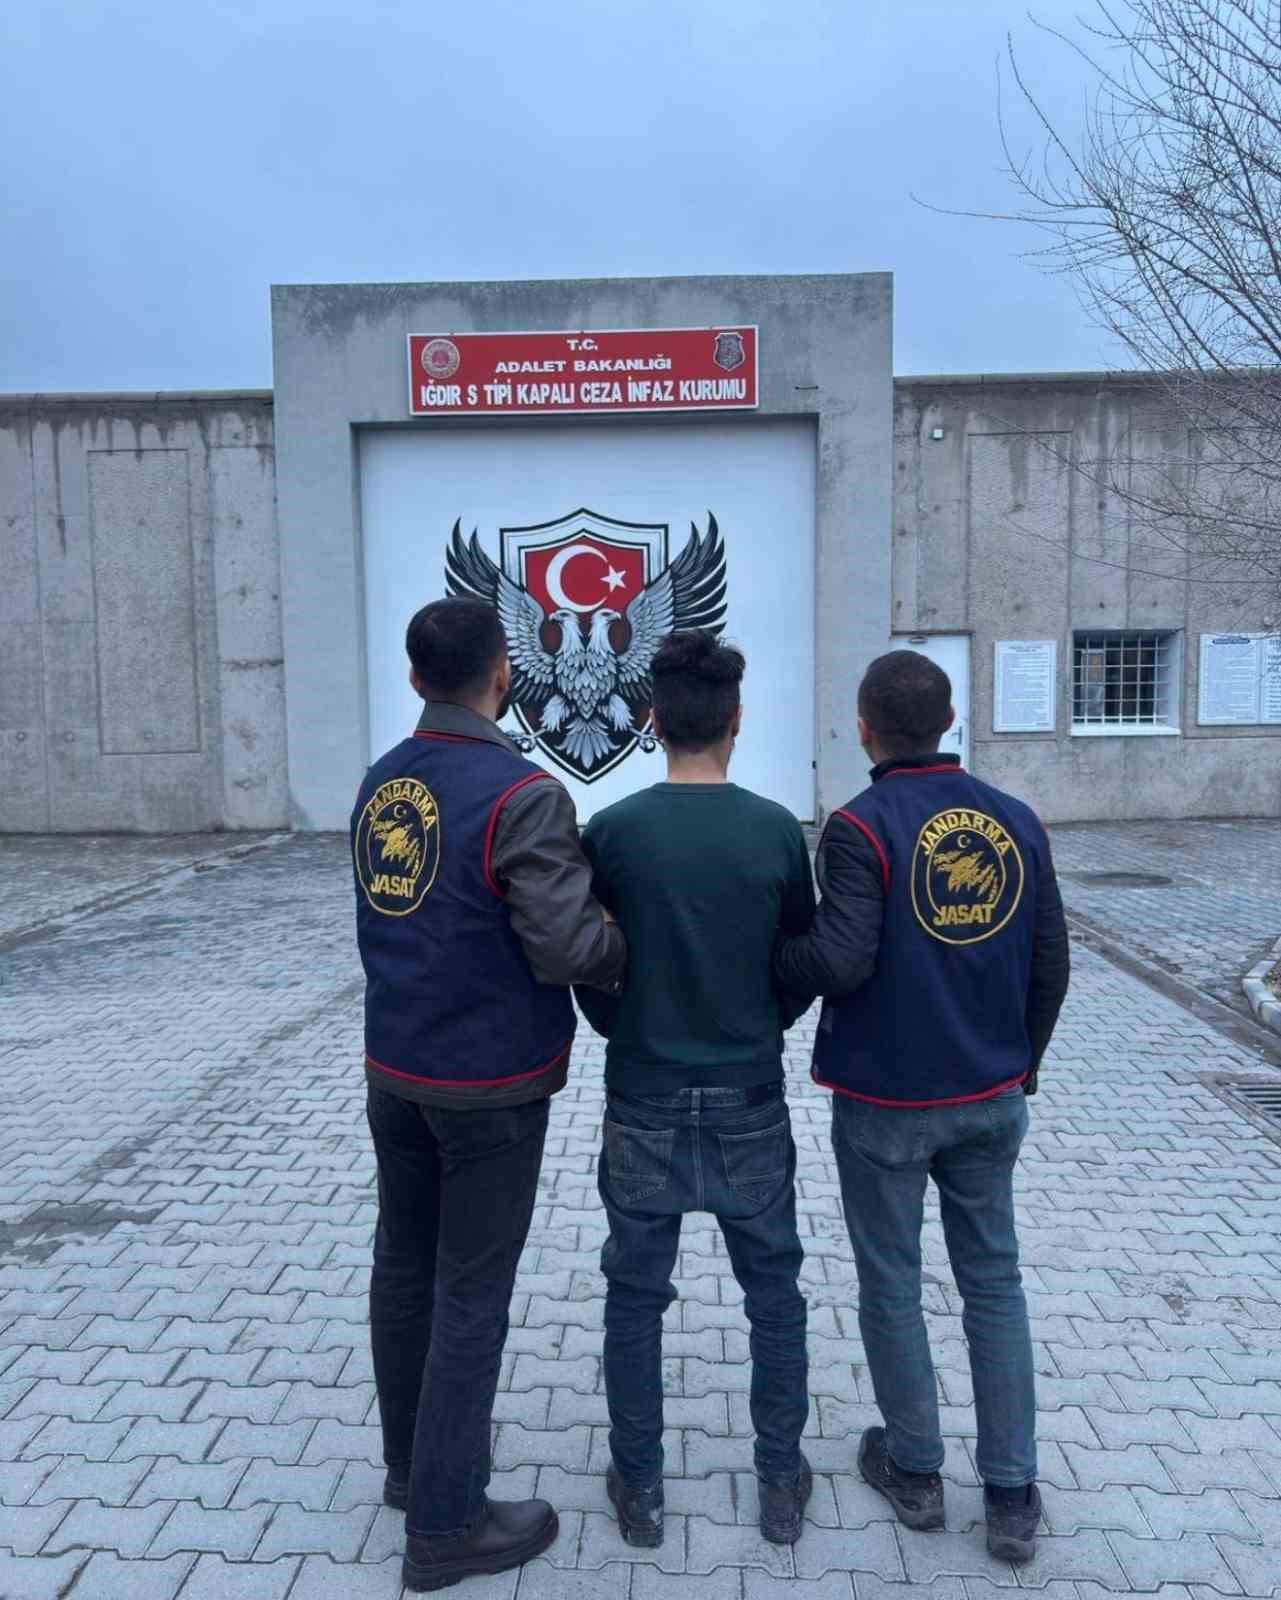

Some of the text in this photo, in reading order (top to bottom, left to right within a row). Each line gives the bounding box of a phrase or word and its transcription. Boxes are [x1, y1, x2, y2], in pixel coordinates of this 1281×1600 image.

[566, 339, 598, 351] T.C.
[495, 353, 672, 373] ADALET BAKANLIĞI
[421, 376, 746, 407] IĞDIR S TİPİ KAPALI CEZA İNFAZ KURUMU
[368, 782, 436, 831] JANDARMA
[920, 813, 1012, 856] JANDARMA
[370, 873, 417, 898] JASAT
[933, 903, 996, 926] JASAT
